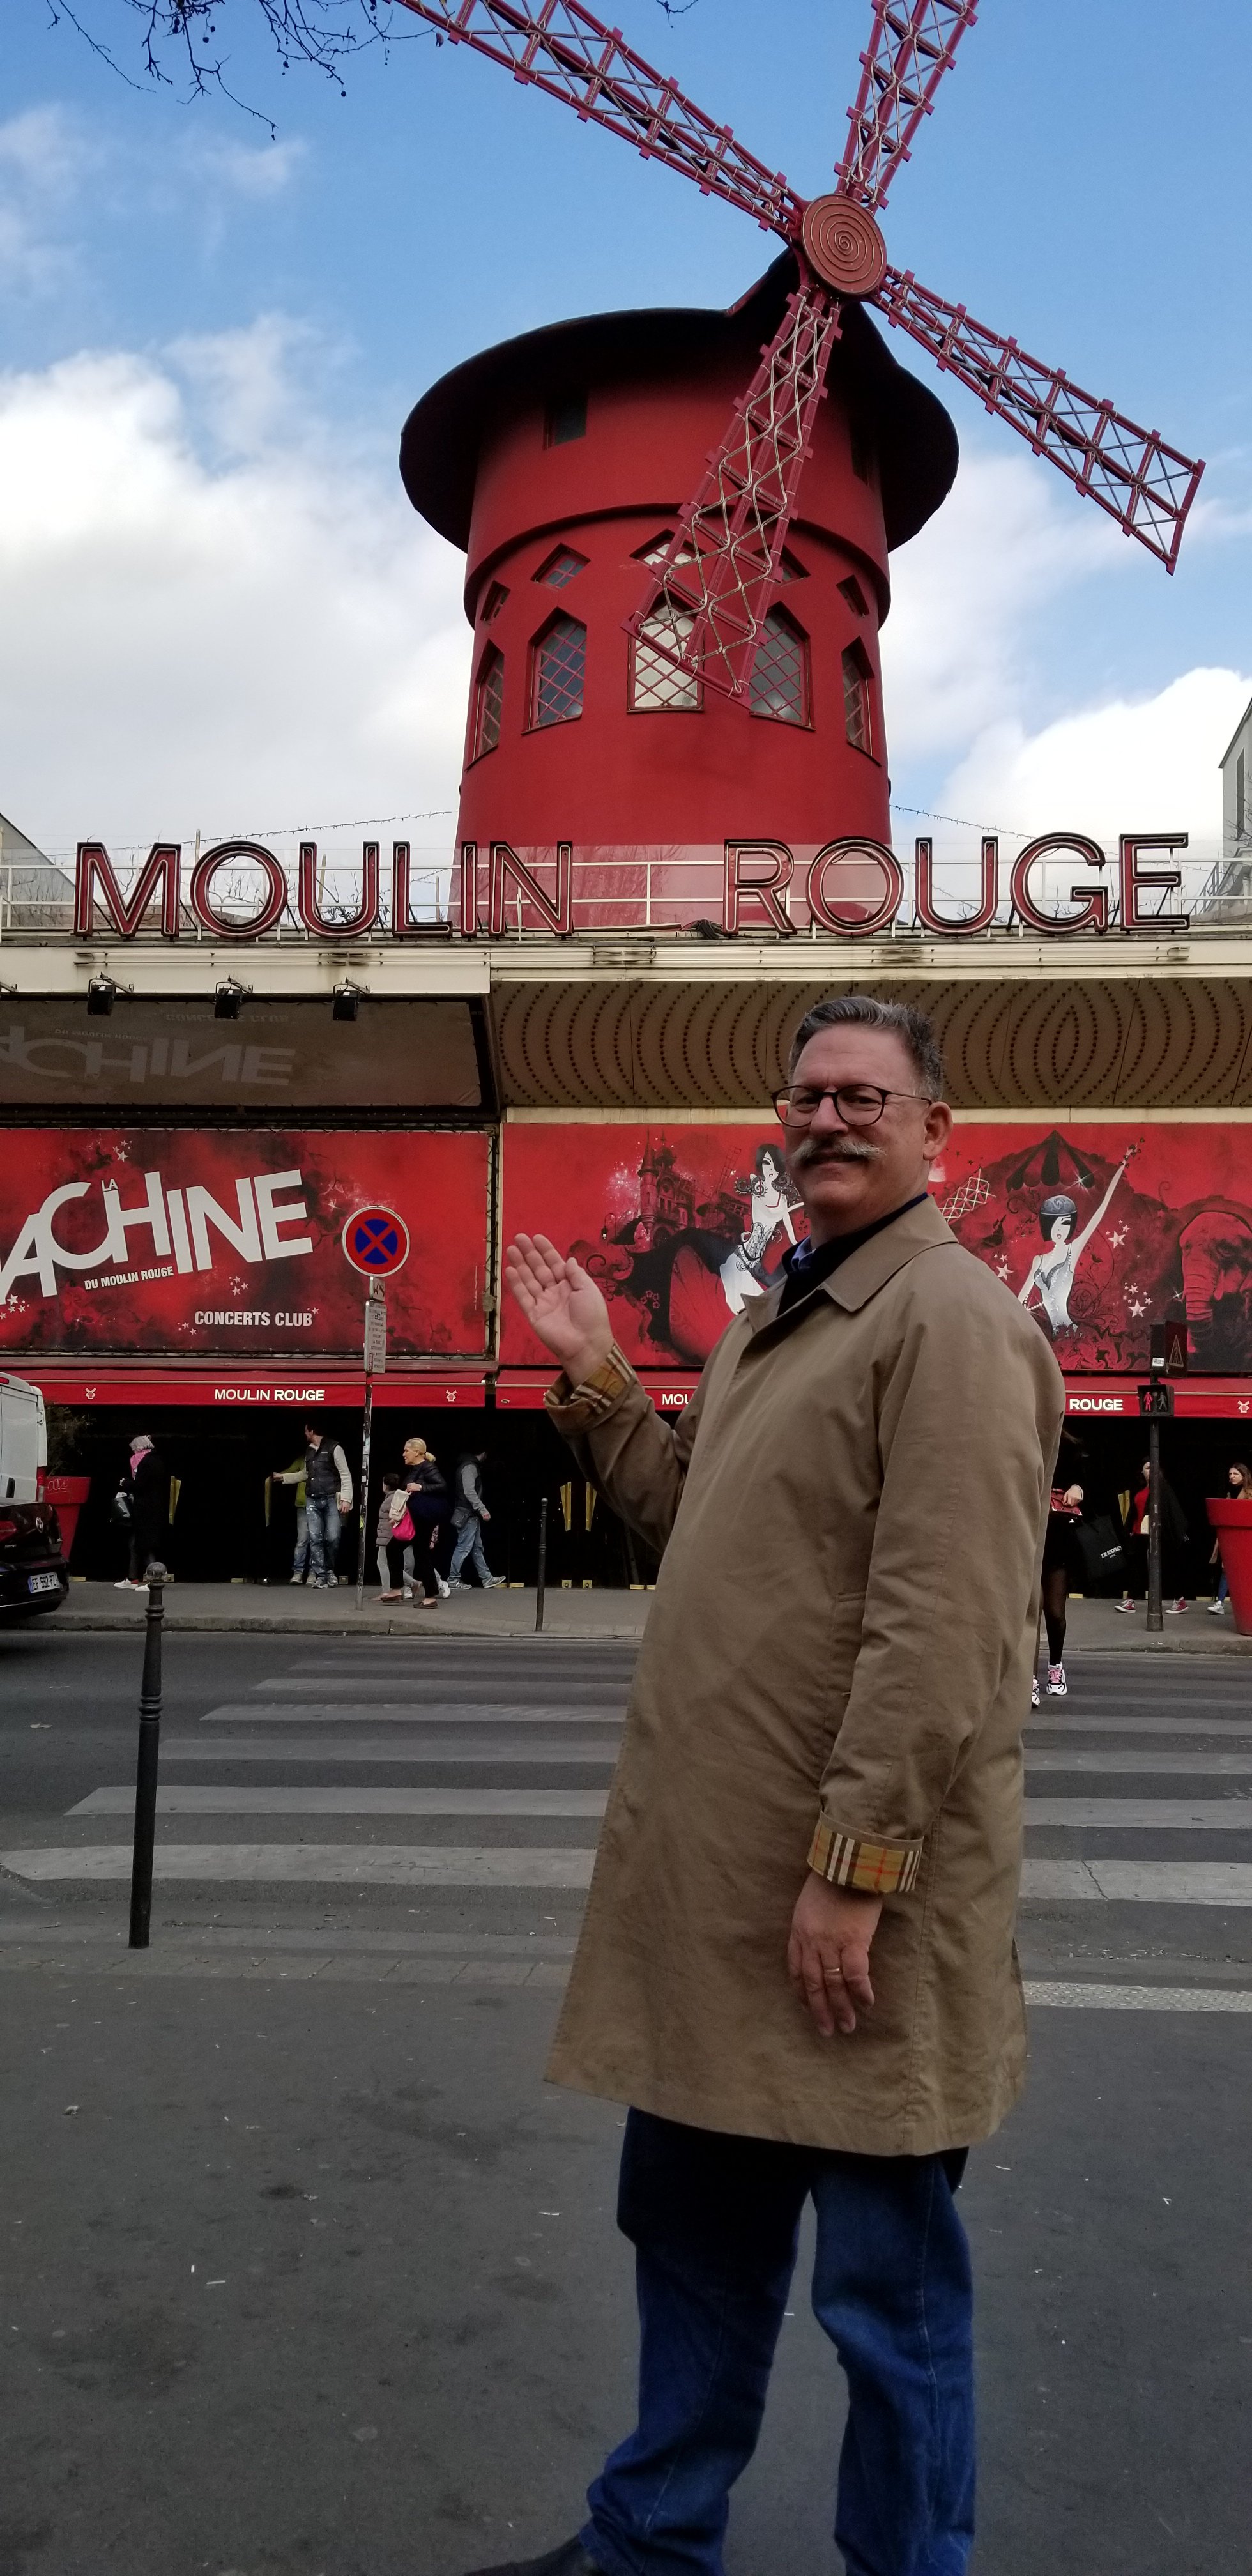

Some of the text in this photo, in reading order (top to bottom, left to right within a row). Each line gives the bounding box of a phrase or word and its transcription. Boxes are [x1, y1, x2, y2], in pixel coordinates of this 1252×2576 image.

[73, 832, 1191, 940] MOULIN ROUGE
[101, 1179, 119, 1192] LA
[0, 1169, 313, 1305] ACHINE
[84, 1266, 174, 1290] DU MOULIN ROUGE
[194, 1311, 313, 1326] CONCERTS CLUB
[215, 1389, 325, 1401] MOULIN ROUGE
[1069, 1399, 1124, 1411] ROUGE
